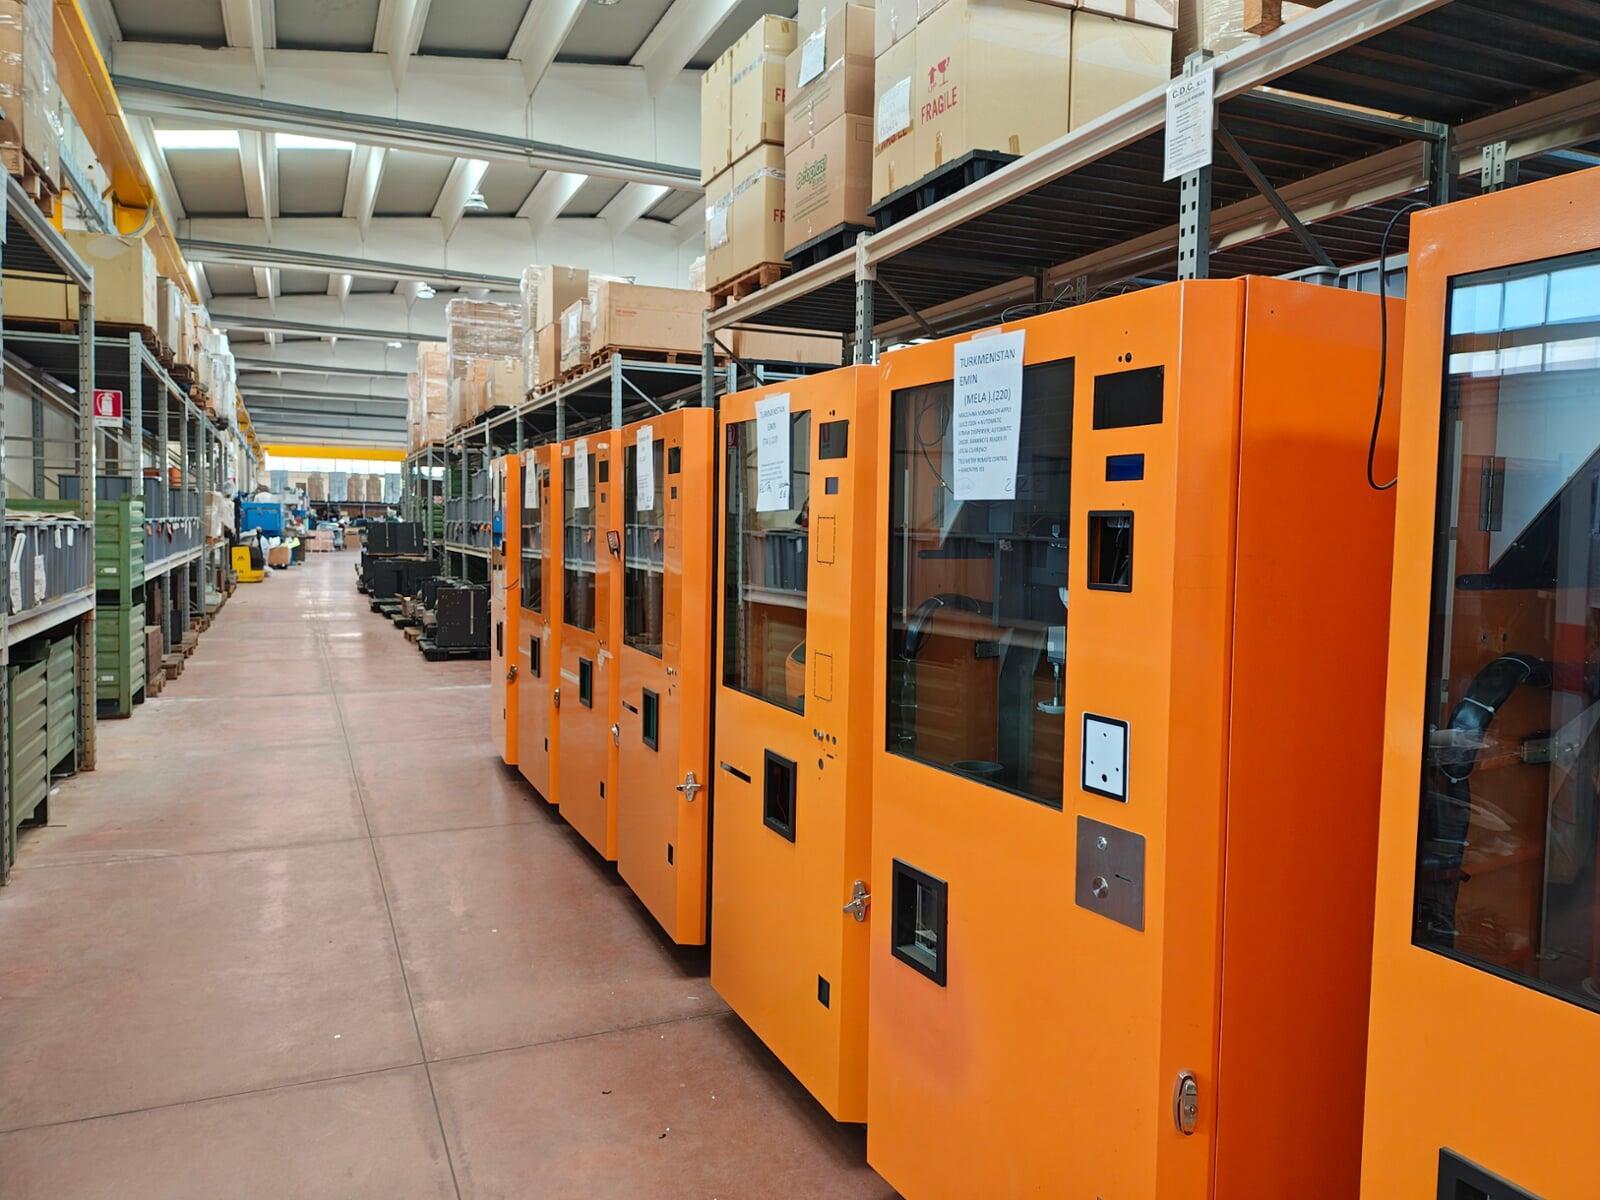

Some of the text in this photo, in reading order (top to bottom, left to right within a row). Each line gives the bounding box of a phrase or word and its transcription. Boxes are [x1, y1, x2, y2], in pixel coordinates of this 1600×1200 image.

[921, 86, 957, 125] FRAGILE
[960, 349, 1016, 368] TURKMENISTAN
[959, 373, 978, 386] EMIN
